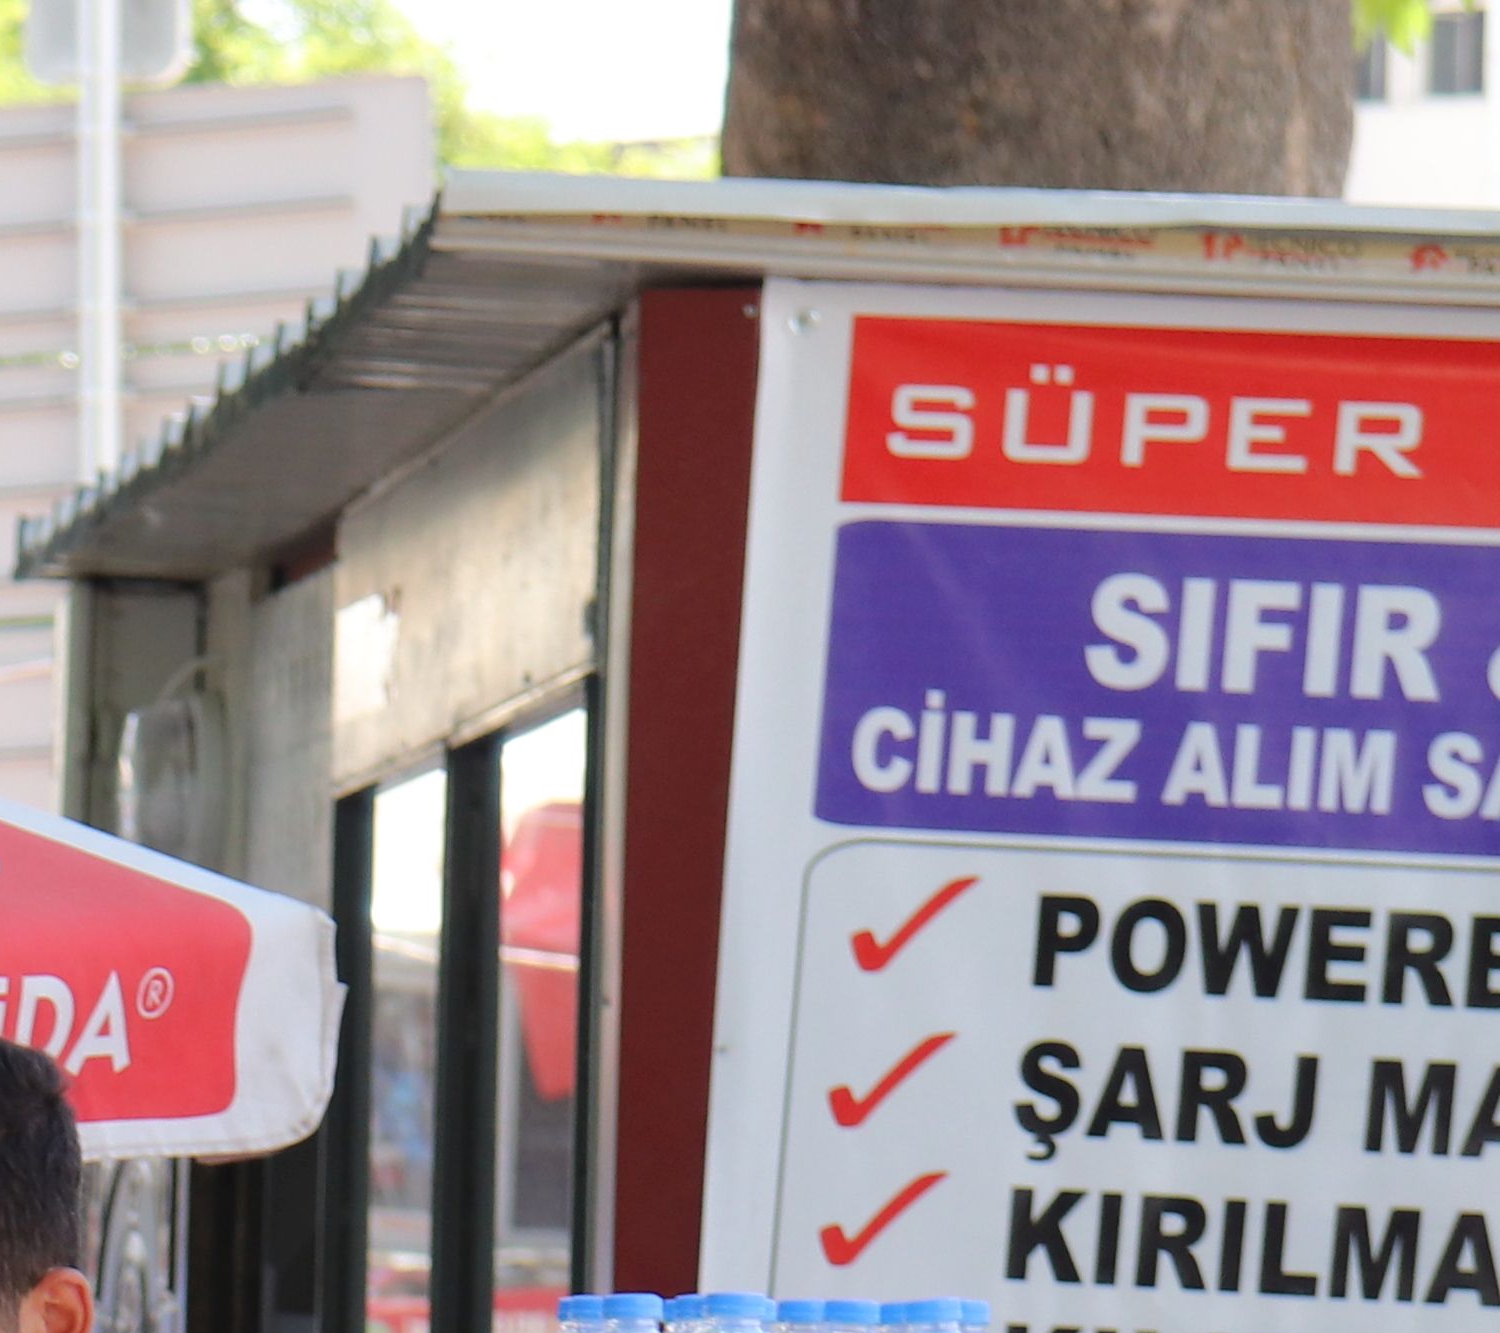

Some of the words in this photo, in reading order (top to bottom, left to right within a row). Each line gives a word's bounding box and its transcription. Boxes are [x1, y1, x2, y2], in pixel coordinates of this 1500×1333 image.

[886, 363, 1425, 479] SÜPER
[1084, 572, 1443, 704] SIFIR
[851, 691, 1143, 803] CİHAZ
[1161, 717, 1398, 815] ALIM
[1422, 729, 1500, 822] S
[1013, 1039, 1320, 1161] ŞARJ
[1005, 1187, 1500, 1307] KIRILMA
